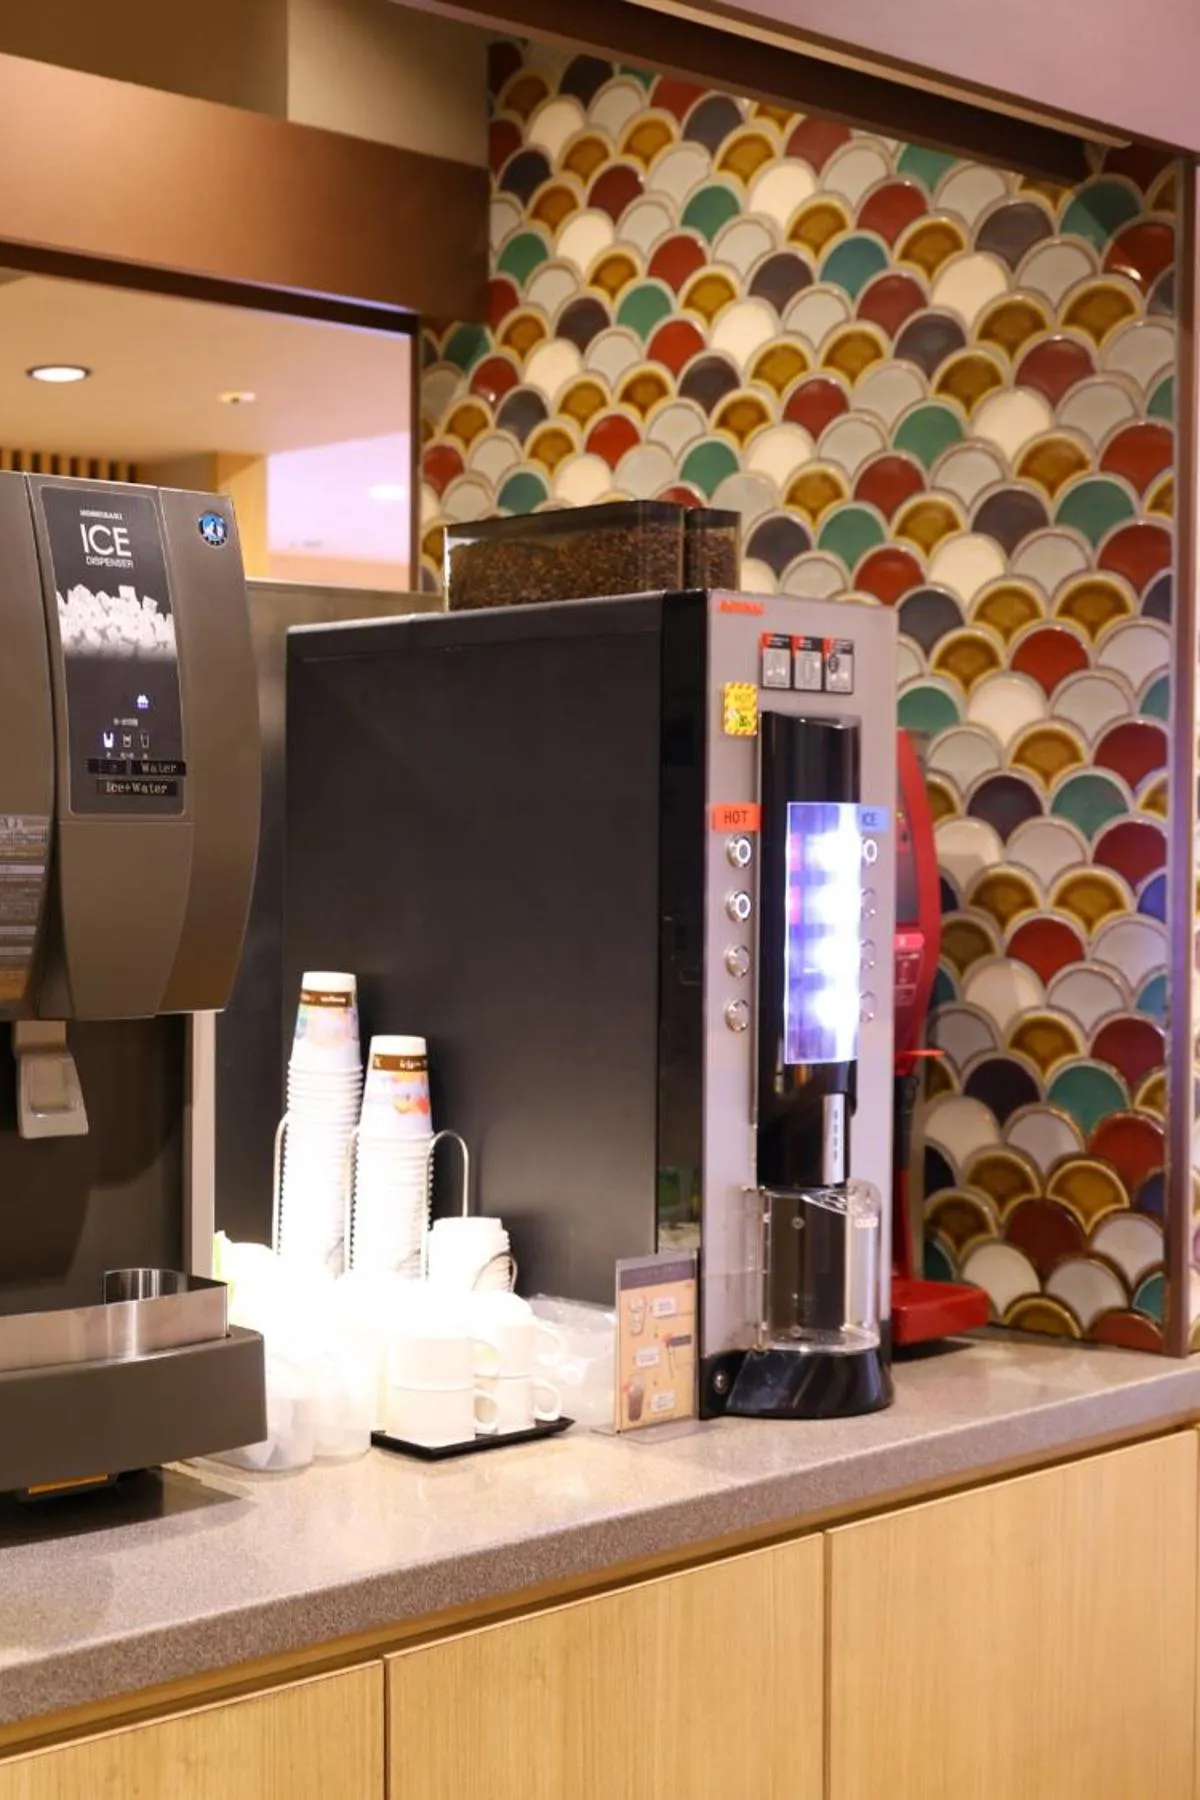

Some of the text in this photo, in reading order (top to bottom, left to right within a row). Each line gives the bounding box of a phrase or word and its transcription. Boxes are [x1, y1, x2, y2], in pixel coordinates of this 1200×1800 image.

[80, 523, 132, 557] ICE
[86, 556, 133, 568] DISPENSER
[141, 761, 177, 773] Water
[106, 781, 167, 794] Ice+Water
[724, 809, 749, 824] HOT
